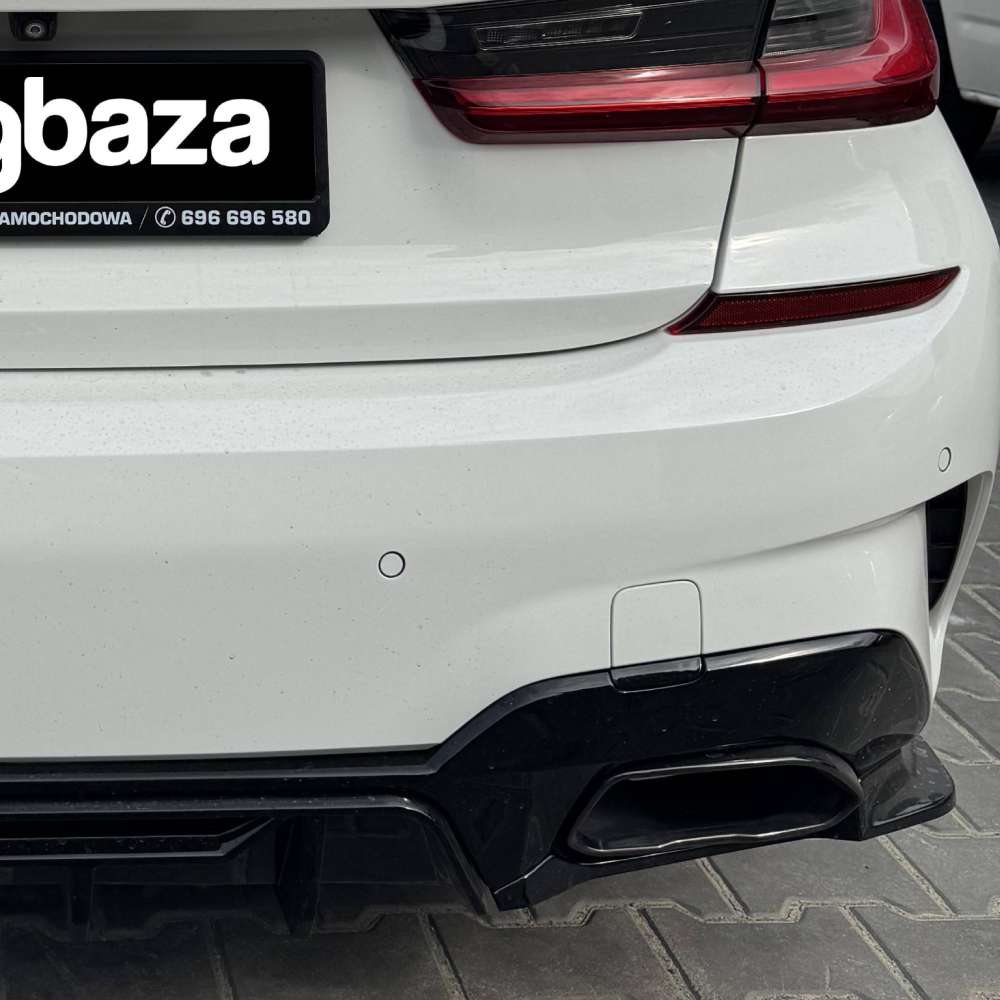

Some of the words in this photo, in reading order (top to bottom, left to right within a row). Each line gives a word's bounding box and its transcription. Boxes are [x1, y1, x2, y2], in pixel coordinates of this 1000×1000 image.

[181, 209, 221, 226] 696
[226, 209, 266, 226] 696
[271, 209, 311, 226] 580
